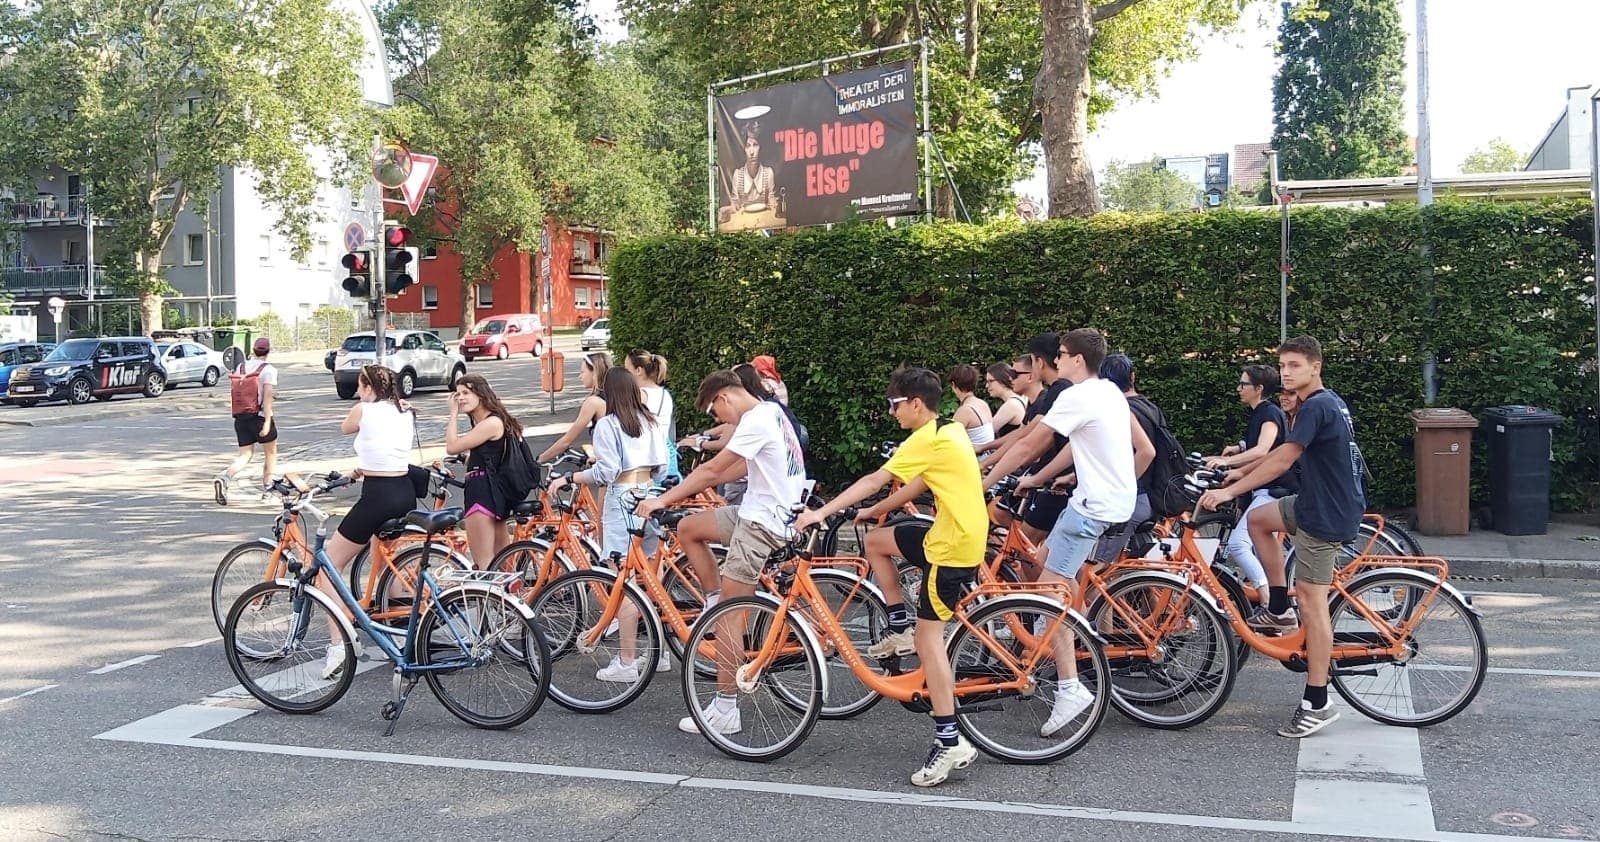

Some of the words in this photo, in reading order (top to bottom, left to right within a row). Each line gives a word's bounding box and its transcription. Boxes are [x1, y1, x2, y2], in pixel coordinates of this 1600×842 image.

[838, 80, 880, 101] THEATER
[884, 73, 904, 89] DER
[838, 88, 905, 116] IMMORALISTEN
[775, 127, 818, 162] "Die
[822, 119, 886, 156] kluge
[806, 158, 860, 197] Else"
